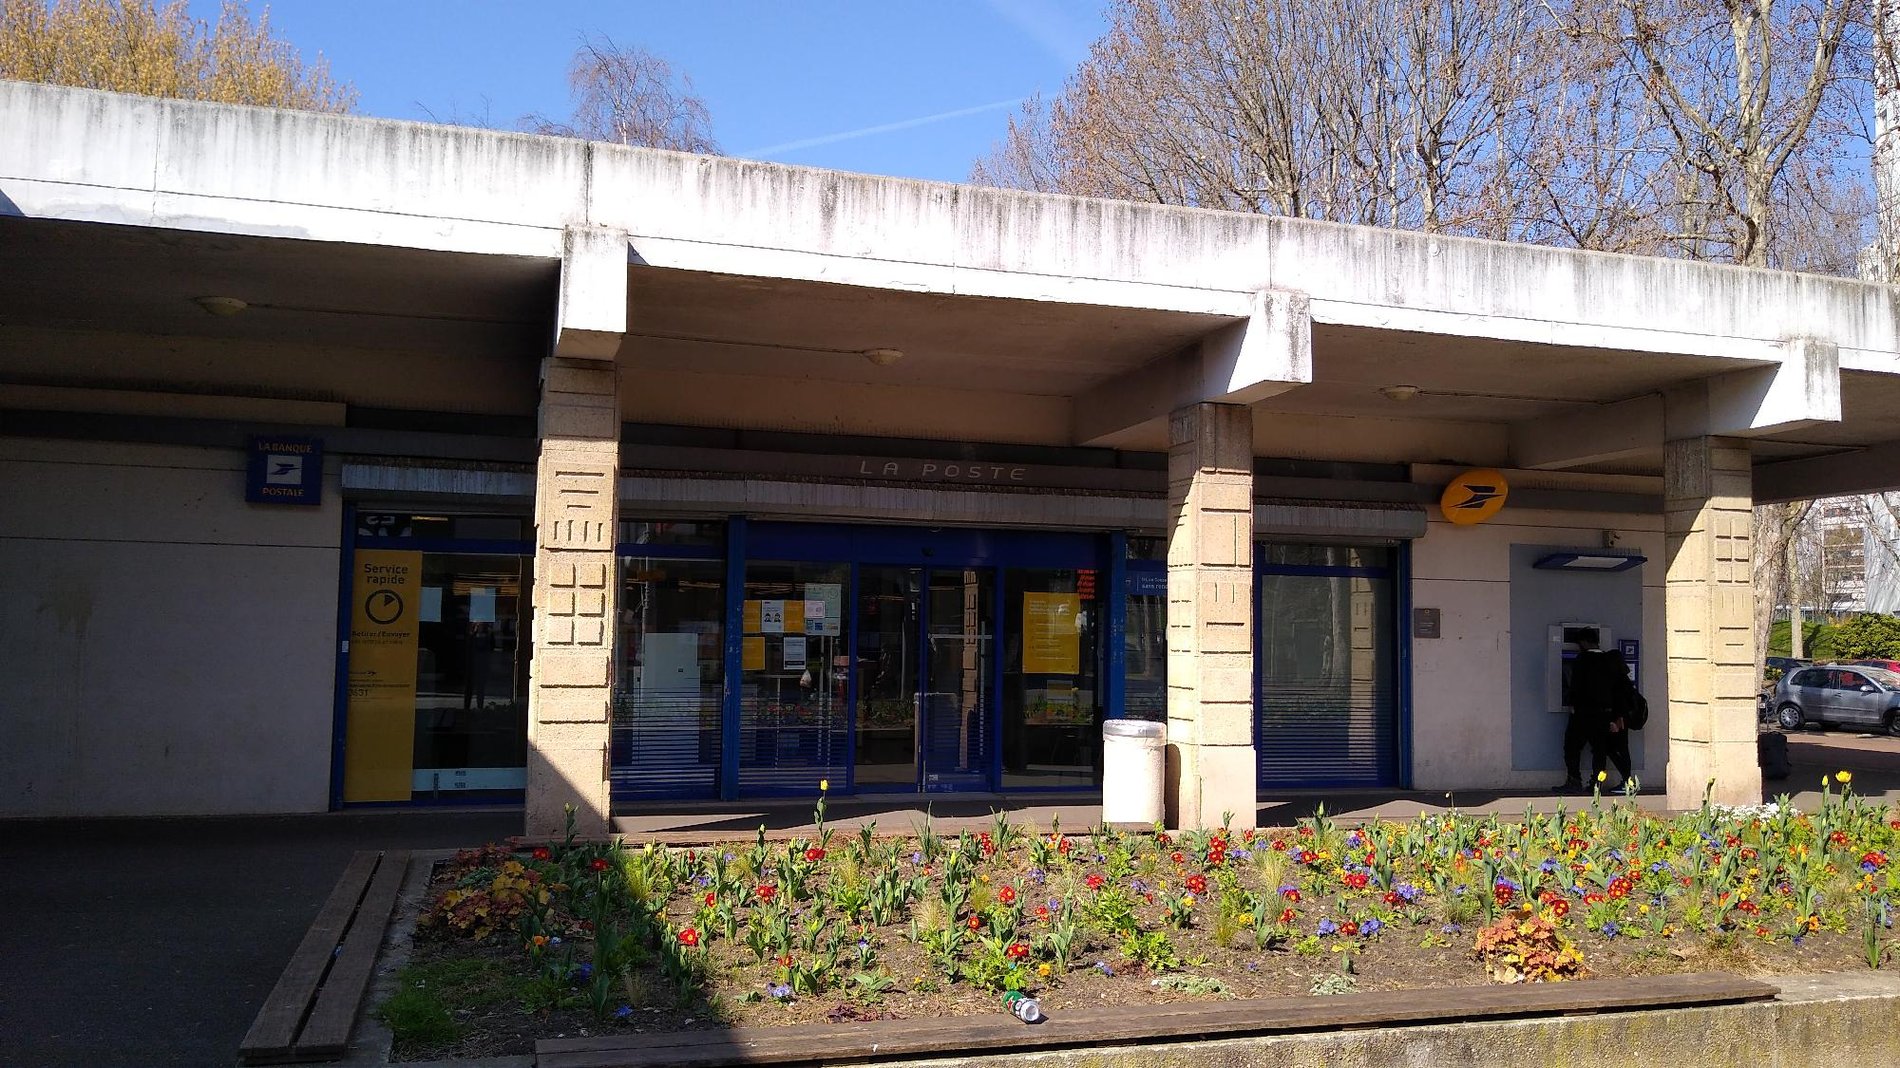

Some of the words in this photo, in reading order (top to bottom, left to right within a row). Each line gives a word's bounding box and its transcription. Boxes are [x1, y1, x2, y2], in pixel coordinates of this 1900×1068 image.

[258, 442, 271, 451] LA
[271, 443, 313, 454] BANQUE
[859, 460, 899, 475] LA
[921, 463, 1027, 481] POSTE
[262, 487, 305, 497] POSTALE
[364, 563, 409, 575] Service
[366, 575, 406, 586] rapide
